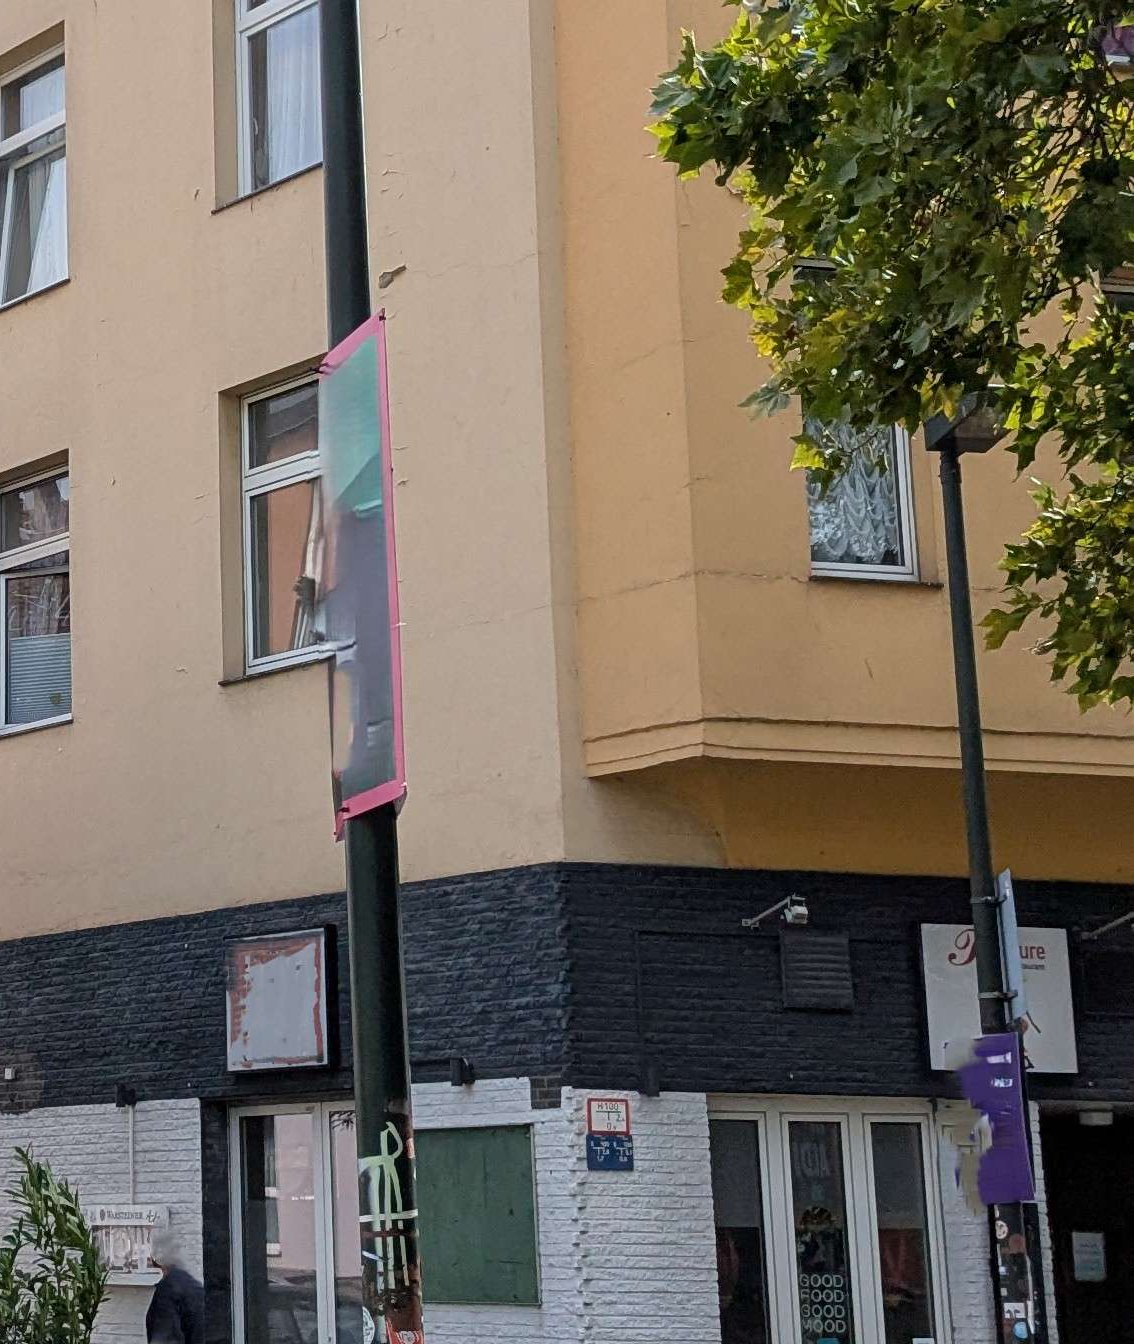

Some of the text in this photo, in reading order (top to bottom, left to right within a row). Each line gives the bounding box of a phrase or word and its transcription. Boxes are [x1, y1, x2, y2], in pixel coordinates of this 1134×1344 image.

[799, 1274, 844, 1288] GOOD
[801, 1289, 845, 1303] FOOD
[801, 1304, 846, 1318] GOOD
[802, 1319, 847, 1334] MOOD
